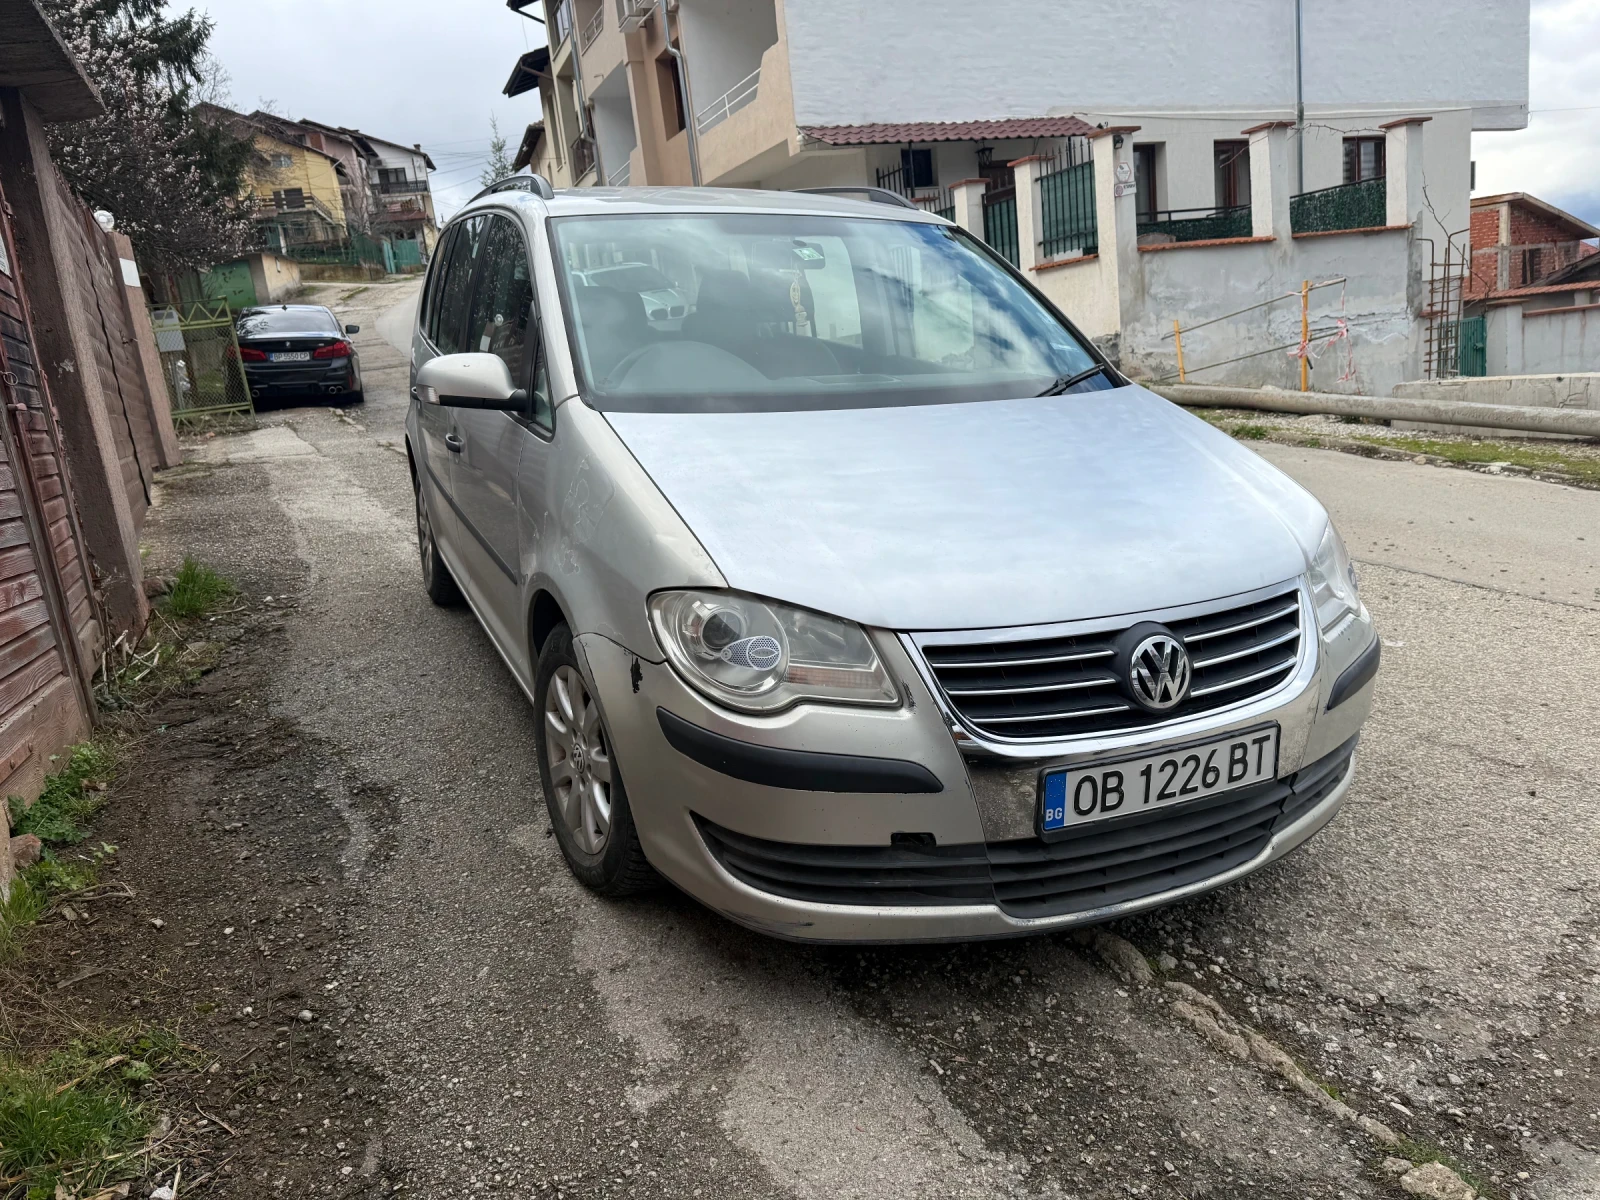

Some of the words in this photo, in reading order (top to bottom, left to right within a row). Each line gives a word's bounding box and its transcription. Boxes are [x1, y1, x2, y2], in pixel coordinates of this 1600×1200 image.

[1131, 635, 1190, 709] VW
[1073, 770, 1125, 816] OB
[1140, 749, 1221, 805] 1226
[1227, 734, 1271, 784] BT
[1045, 807, 1063, 822] BG
